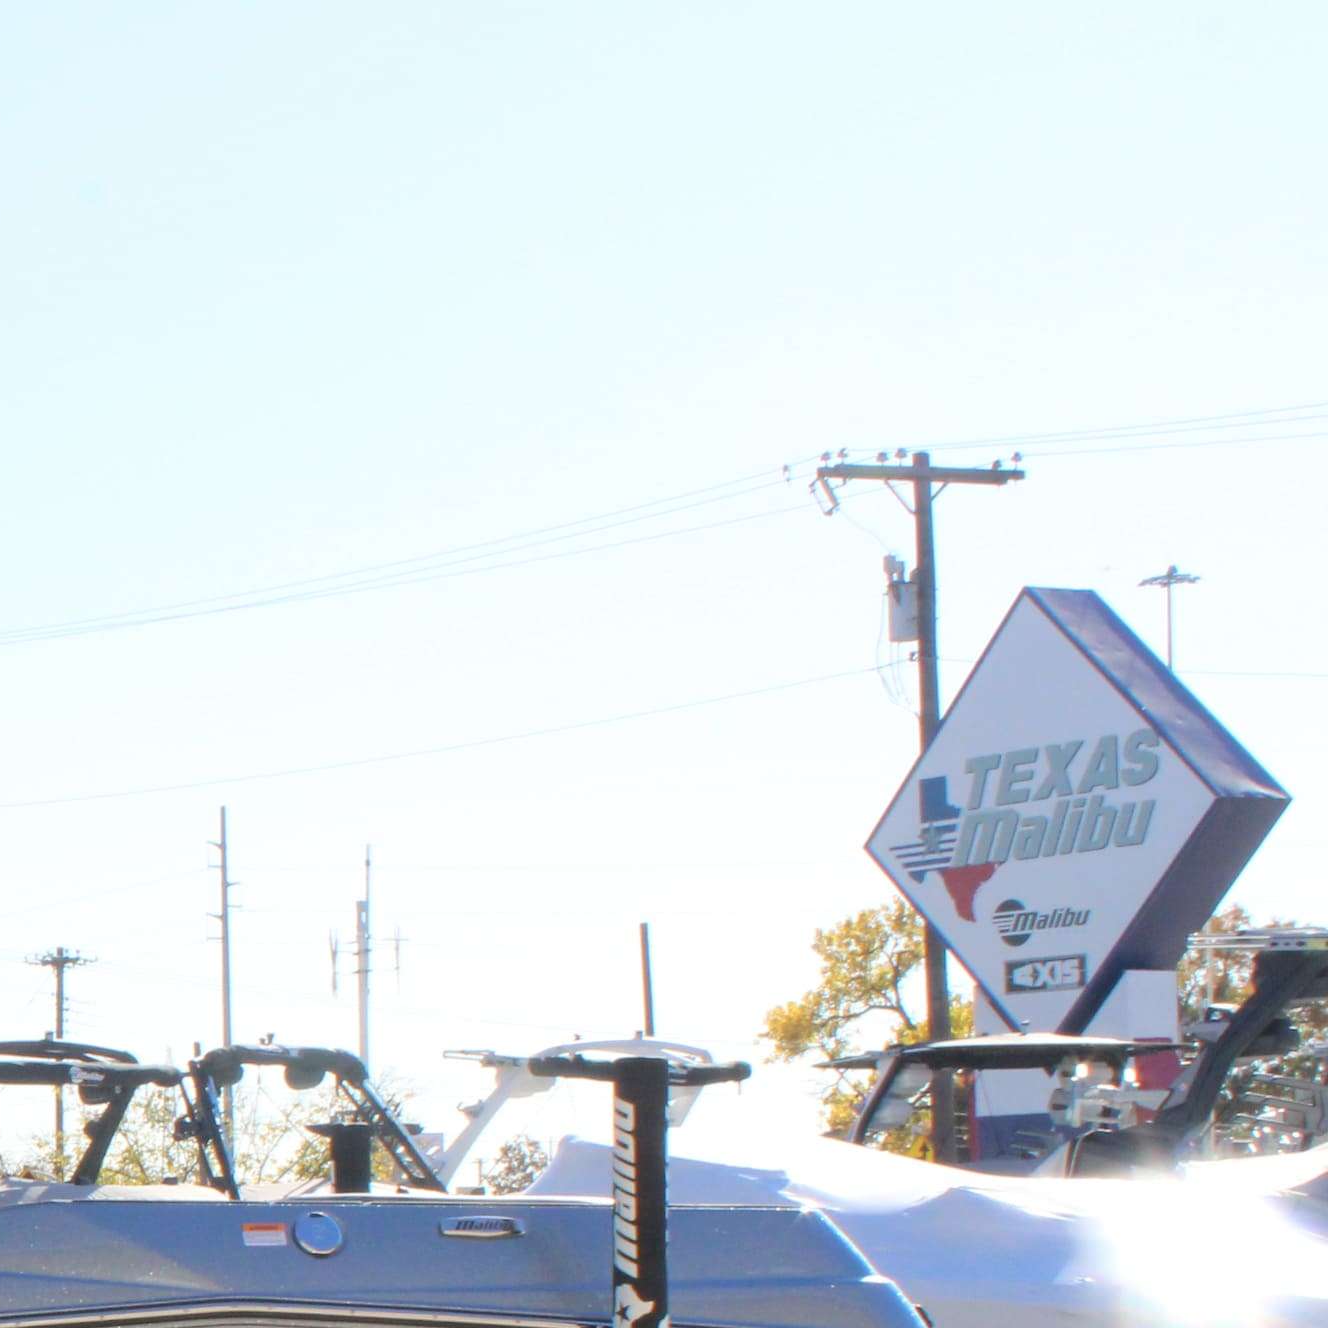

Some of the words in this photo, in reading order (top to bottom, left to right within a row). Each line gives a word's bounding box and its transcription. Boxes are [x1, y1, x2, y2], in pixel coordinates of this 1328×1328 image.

[964, 728, 1159, 811] TEXAS
[951, 795, 1157, 867] Malibu
[1012, 907, 1090, 932] Malibu
